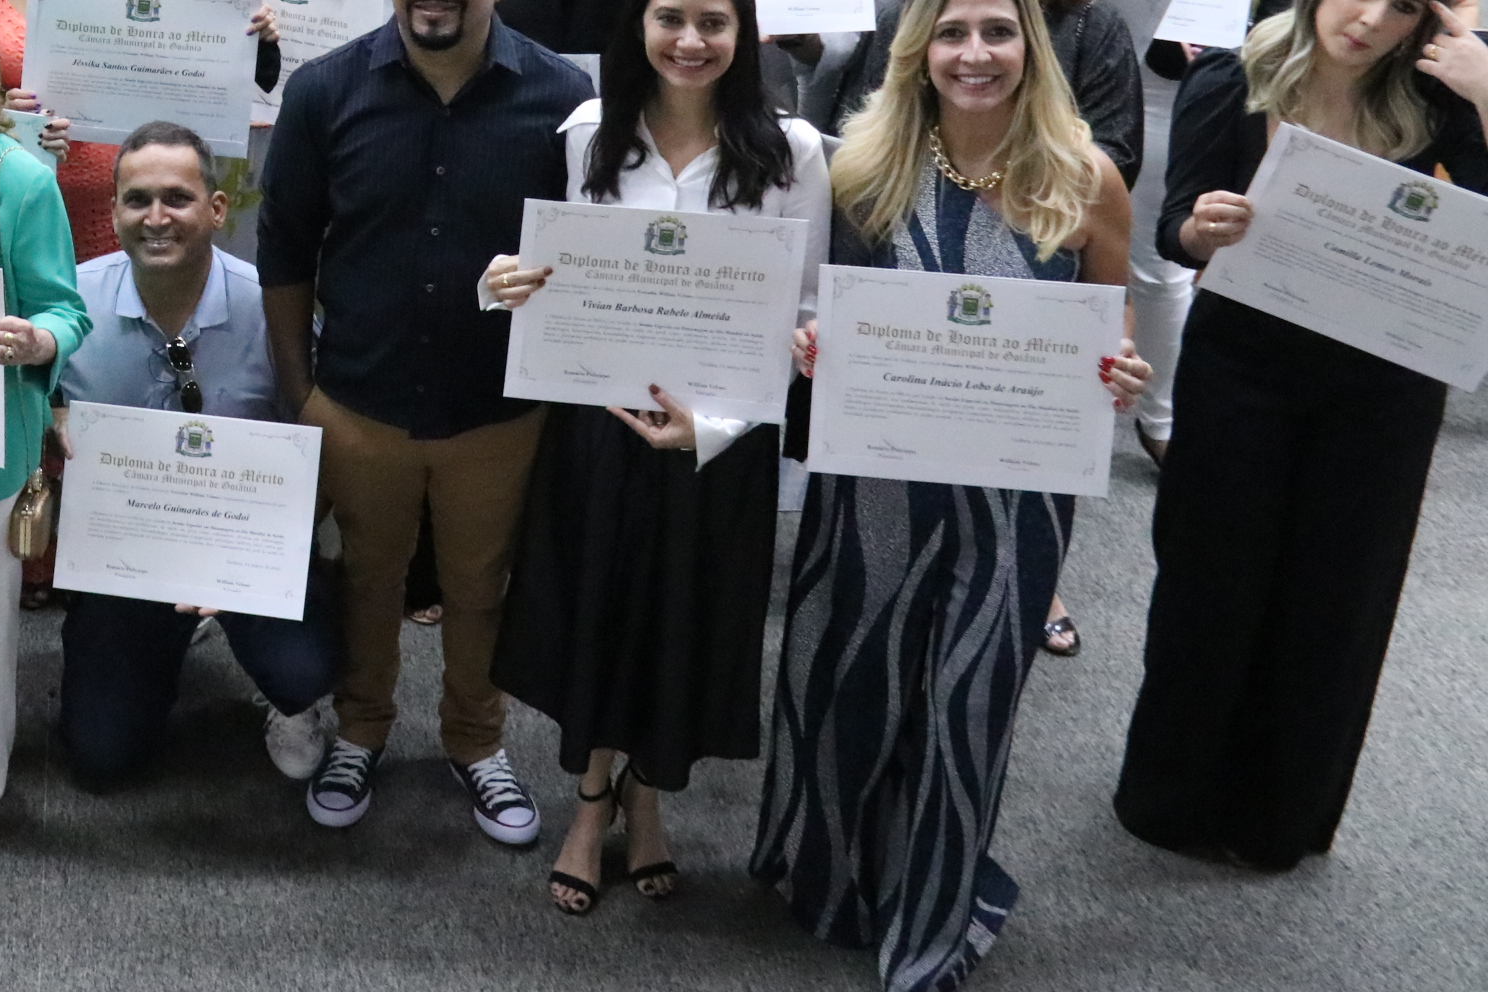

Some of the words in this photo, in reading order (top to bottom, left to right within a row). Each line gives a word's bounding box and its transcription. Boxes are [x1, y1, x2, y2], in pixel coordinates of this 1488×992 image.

[56, 19, 106, 36] Diploma
[110, 25, 122, 36] de
[127, 25, 164, 39] Honra
[168, 32, 182, 40] ao
[186, 31, 226, 44] Mérito
[558, 252, 619, 271] Diploma
[624, 259, 639, 271] de
[644, 259, 690, 275] Honra
[694, 268, 710, 277] ao
[716, 266, 765, 282] Mérito
[857, 321, 921, 342] Diploma
[926, 329, 942, 342] de
[948, 329, 997, 347] Honra
[1002, 339, 1020, 349] ao
[1025, 337, 1079, 354] Mérito
[100, 452, 153, 472] Diploma
[158, 460, 171, 472] de
[176, 461, 216, 477] Honra
[221, 470, 235, 479] ao
[240, 469, 284, 485] Mérito
